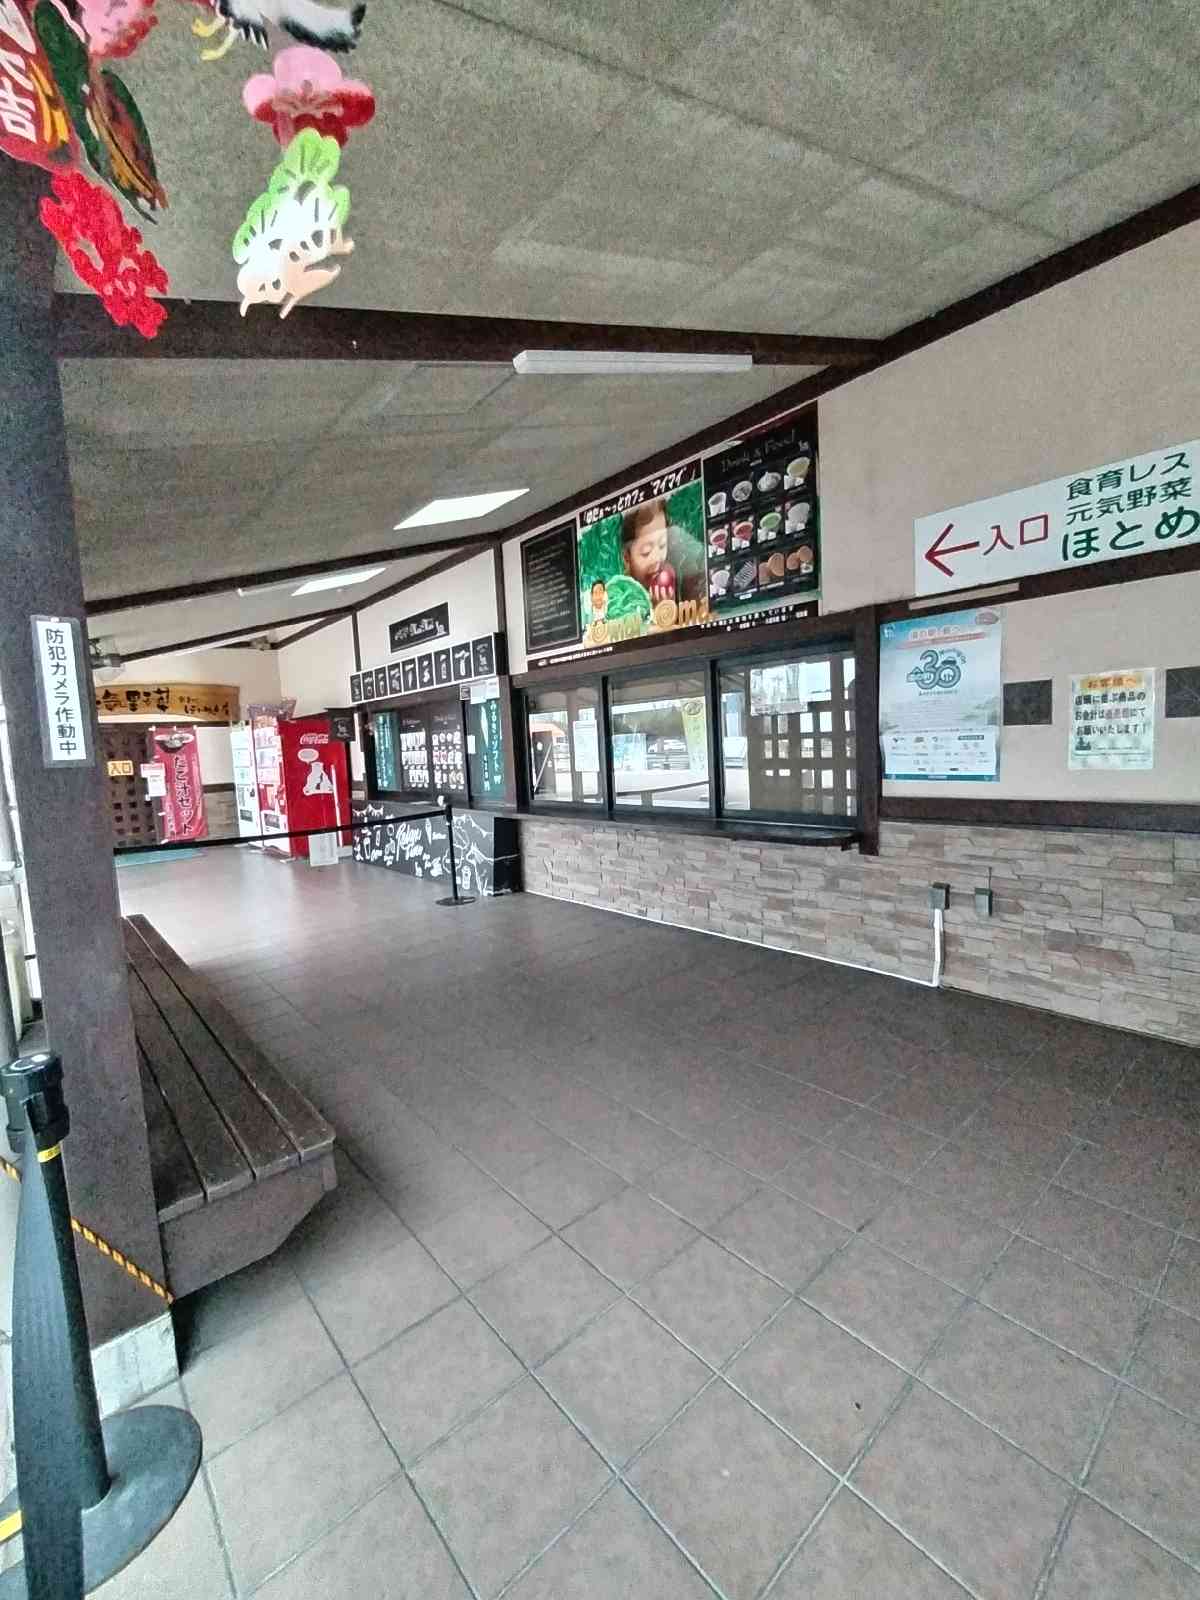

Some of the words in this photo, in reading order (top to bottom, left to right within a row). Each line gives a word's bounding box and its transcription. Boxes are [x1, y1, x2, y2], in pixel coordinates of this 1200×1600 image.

[1067, 452, 1190, 500] 食育レス
[1066, 477, 1192, 525] 元気野菜
[983, 514, 1049, 555] 入口
[1062, 506, 1200, 561] ほとめ
[46, 628, 77, 755] 防犯カメラ作動中
[96, 686, 170, 712] 気野菜
[300, 733, 329, 745] Coca-Cola
[110, 761, 133, 775] 入口
